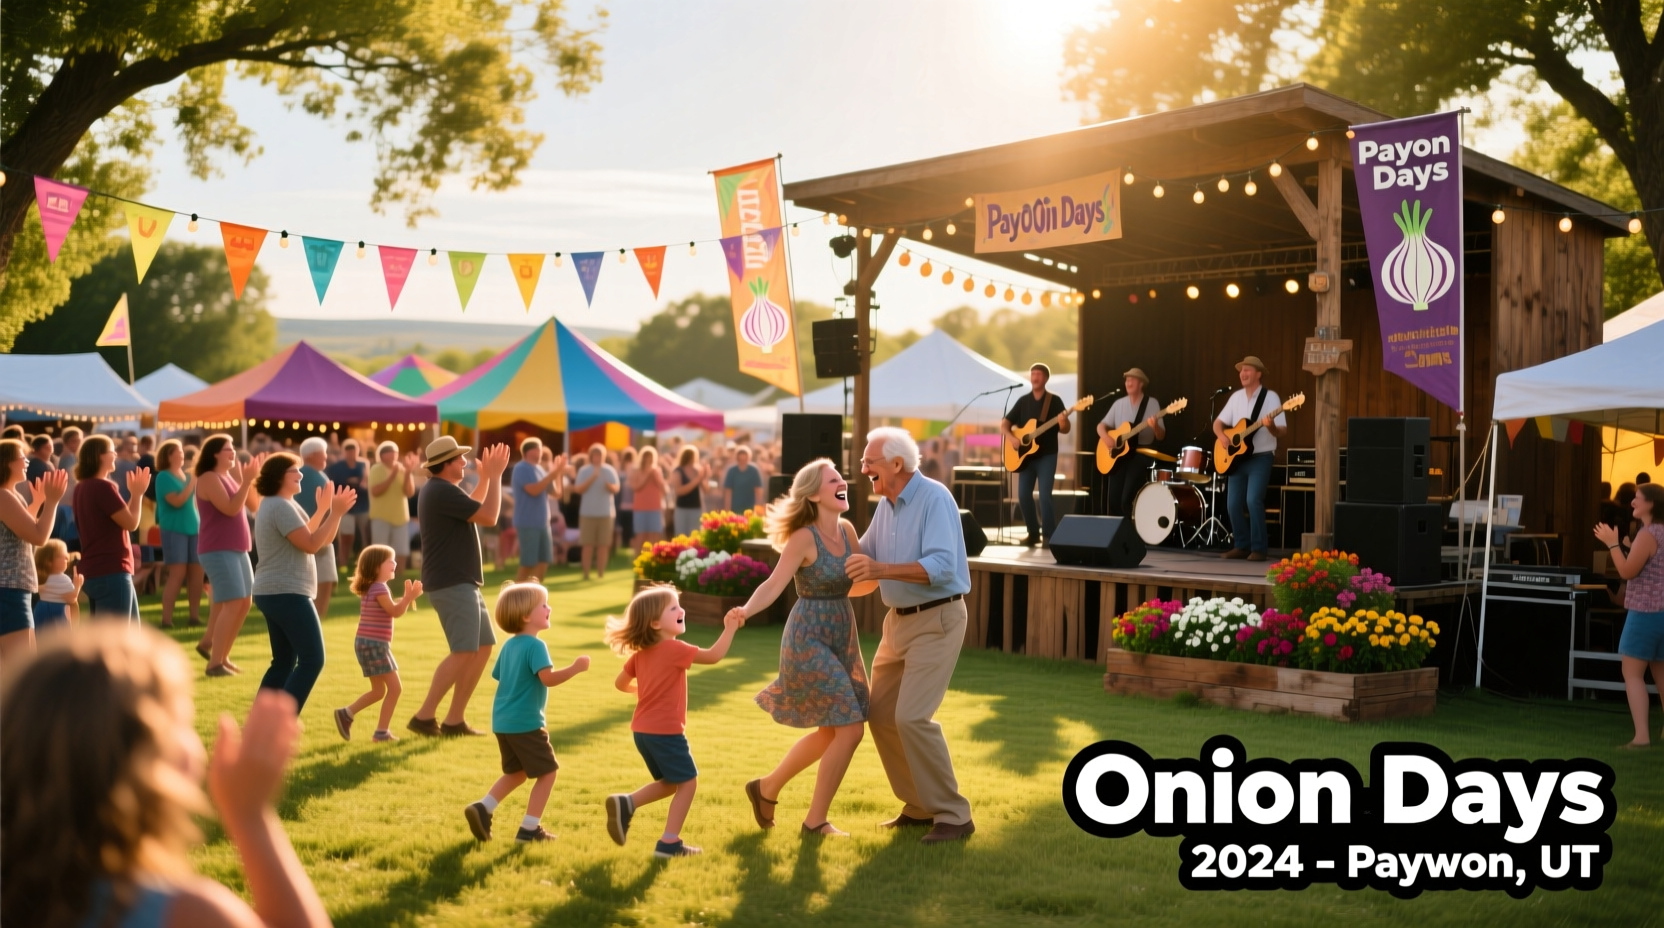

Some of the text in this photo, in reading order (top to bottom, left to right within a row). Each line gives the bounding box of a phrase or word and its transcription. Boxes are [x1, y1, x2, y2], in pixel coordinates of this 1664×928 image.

[1358, 135, 1451, 167] Payon
[1373, 161, 1449, 192] Days
[1061, 195, 1105, 235] Days
